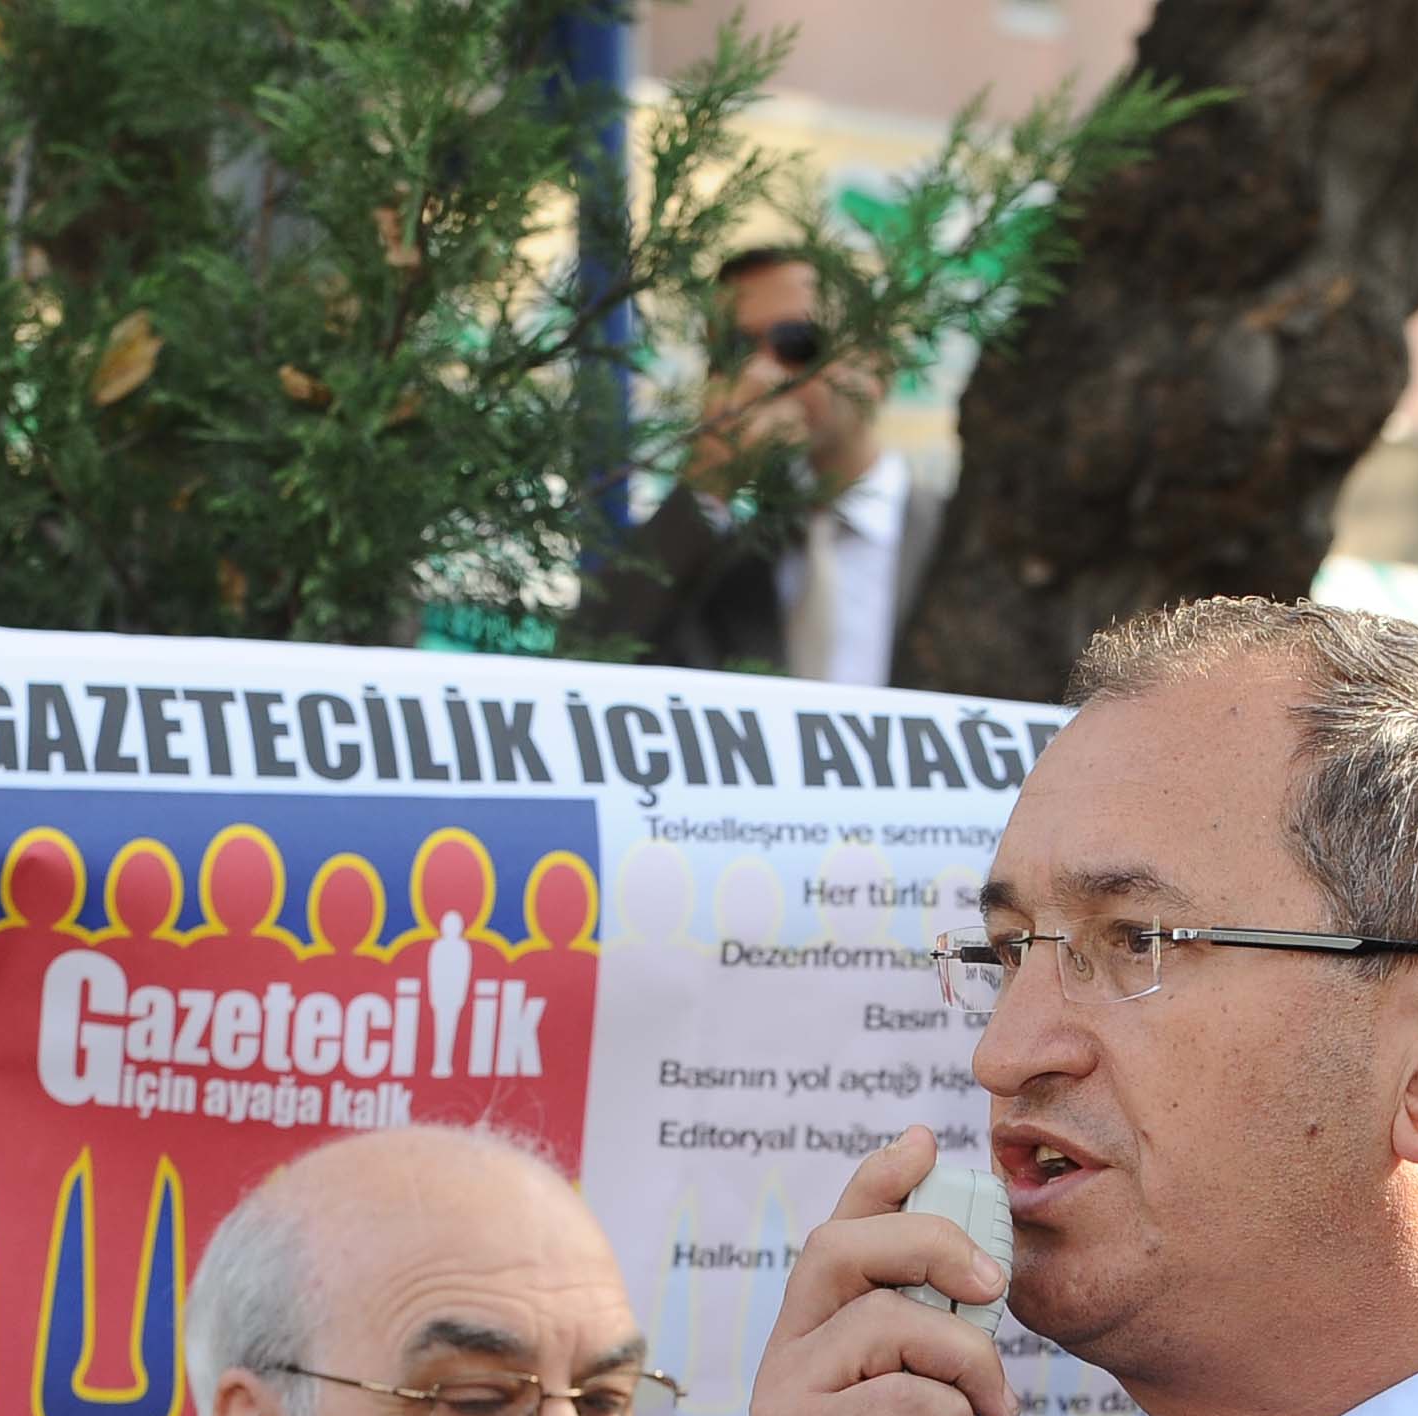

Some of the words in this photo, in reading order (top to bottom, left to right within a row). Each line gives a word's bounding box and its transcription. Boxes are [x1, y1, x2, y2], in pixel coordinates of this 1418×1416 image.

[567, 691, 776, 807] İÇİN
[645, 816, 829, 849] Tekelleşme
[837, 823, 874, 845] ve
[882, 824, 1005, 854] sermay
[803, 879, 857, 906] Her
[868, 878, 939, 908] türlü
[720, 939, 935, 970] Dezenformas
[122, 1064, 196, 1119] için
[203, 1074, 323, 1128] ayağa
[330, 1079, 412, 1129] kalk
[787, 1065, 830, 1097] yol
[659, 1121, 796, 1156] Editoryal
